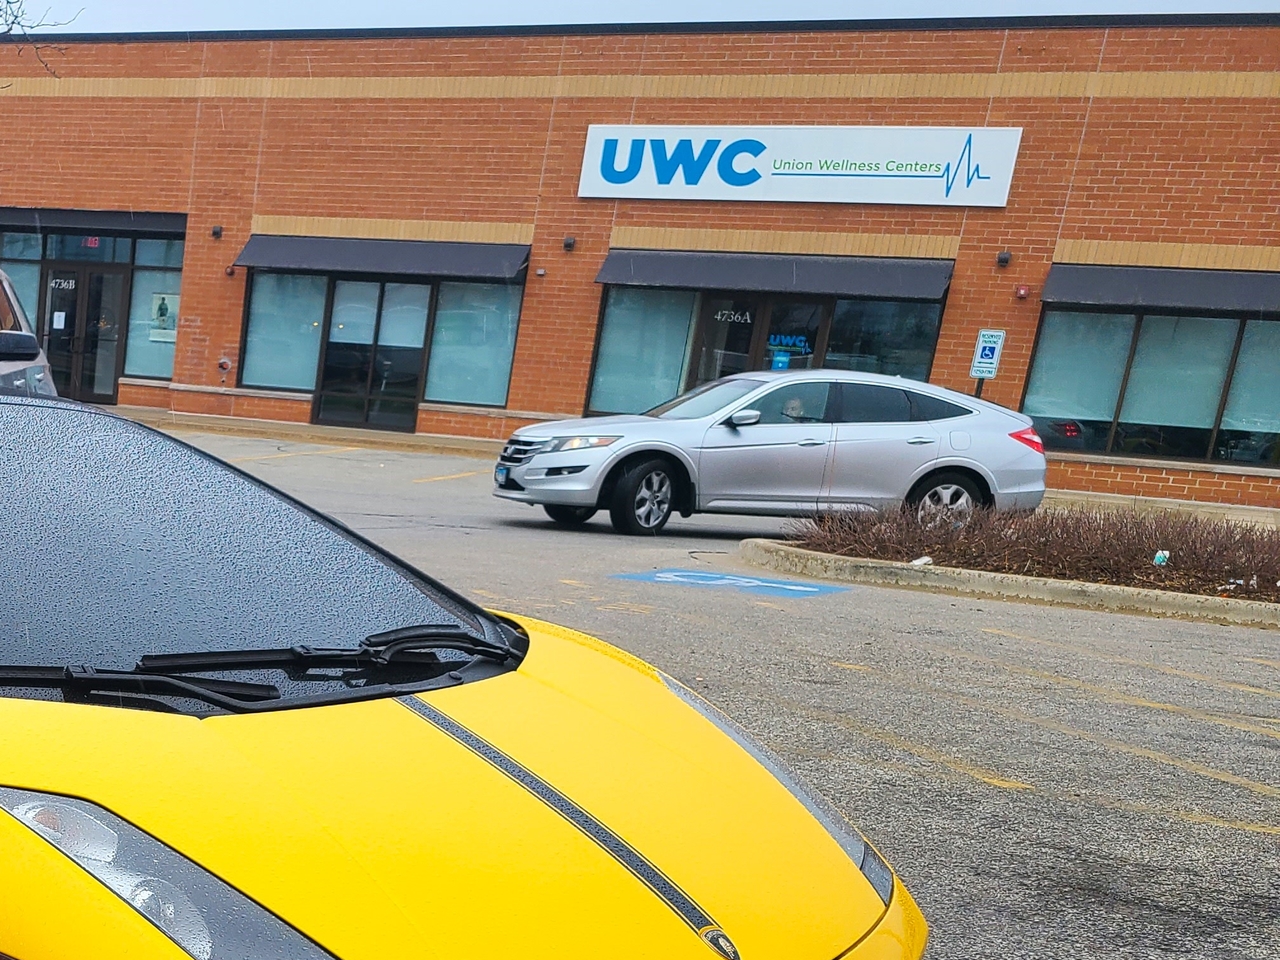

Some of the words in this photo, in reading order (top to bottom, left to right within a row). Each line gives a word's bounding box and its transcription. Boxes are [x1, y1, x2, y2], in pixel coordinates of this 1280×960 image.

[600, 138, 767, 187] UWC
[772, 158, 813, 170] Union
[818, 159, 880, 172] Wellness
[885, 160, 942, 173] Centers
[50, 279, 76, 290] 4736B
[714, 310, 752, 323] 4736A
[769, 334, 807, 347] UWC
